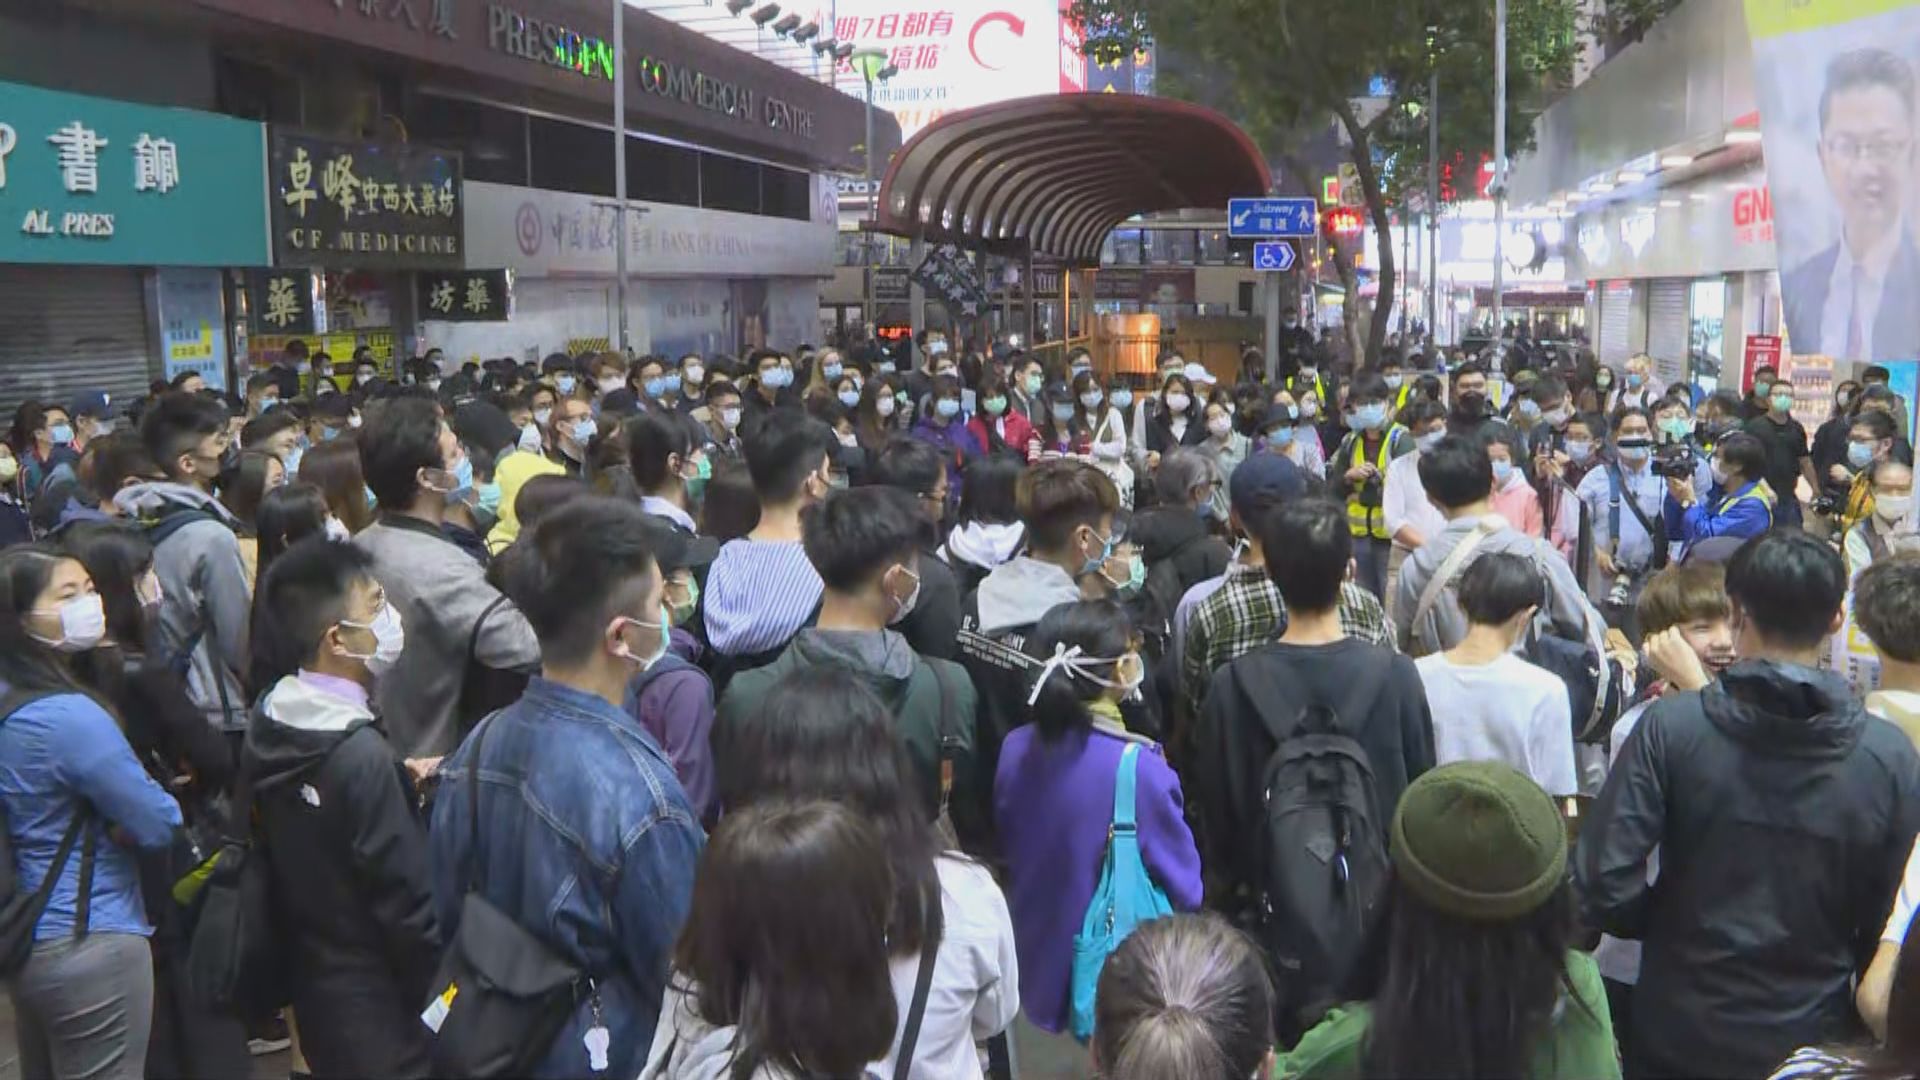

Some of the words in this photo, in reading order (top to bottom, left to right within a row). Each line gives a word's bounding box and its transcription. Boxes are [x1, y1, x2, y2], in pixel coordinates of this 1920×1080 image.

[488, 3, 627, 81] PRESIDEN
[639, 55, 755, 121] COMMERCIAL
[764, 96, 816, 138] CENTRE
[20, 208, 55, 234] AL
[1253, 202, 1296, 216] Subway
